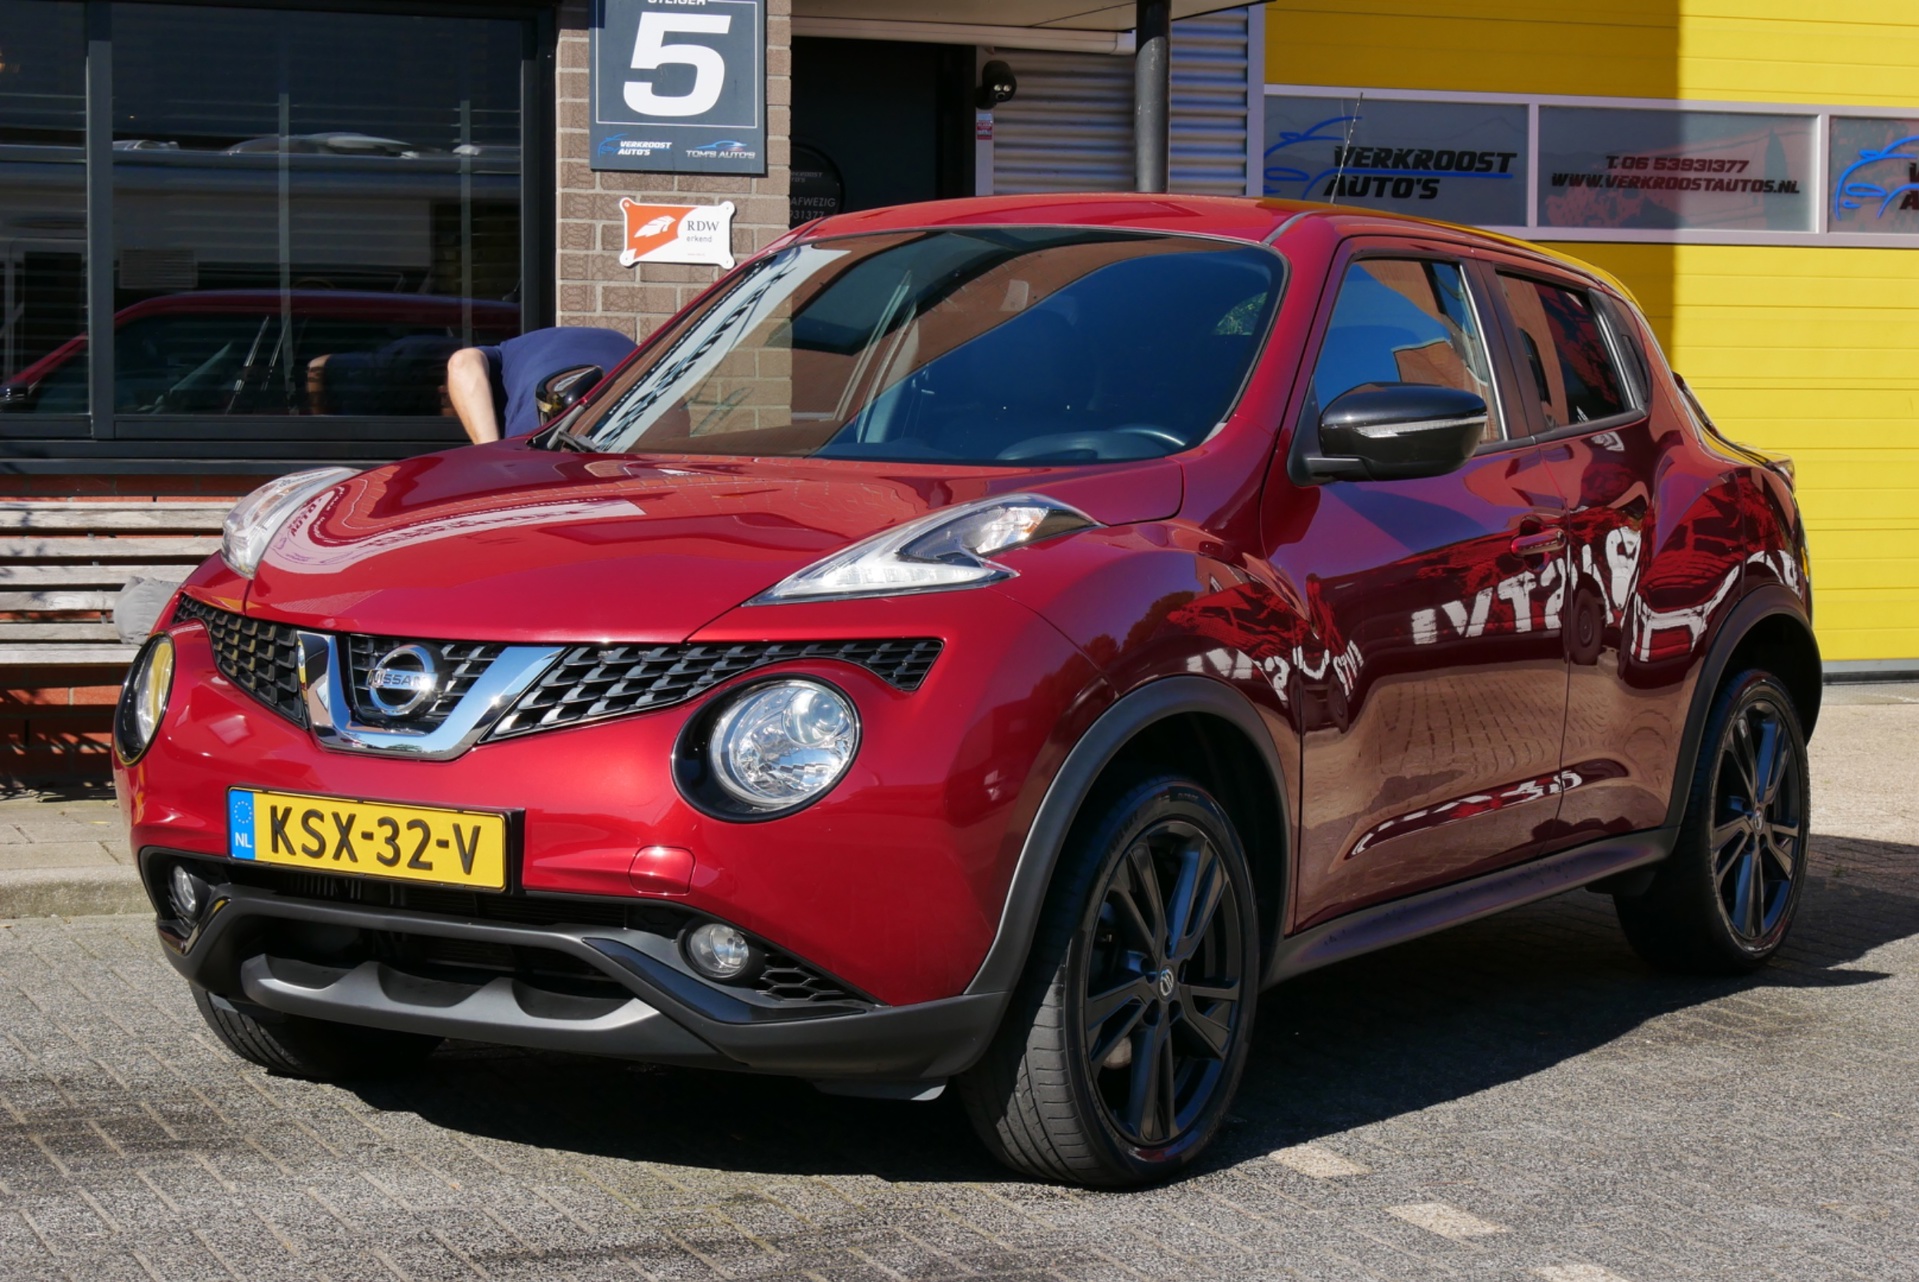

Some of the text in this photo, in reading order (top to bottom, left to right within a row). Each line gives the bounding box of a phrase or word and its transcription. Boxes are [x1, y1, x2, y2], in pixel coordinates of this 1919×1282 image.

[623, 11, 732, 117] 5
[620, 140, 672, 150] VERKROOST
[686, 150, 756, 159] TOM'S AUTO'S
[1334, 146, 1518, 174] VERKROOST
[1653, 157, 1750, 174] 53931377
[1323, 175, 1441, 200] AUTO'S
[1551, 172, 1801, 195] WWW.VERKROOSTAUTOS.NL
[791, 197, 836, 208] AFWEZIG
[687, 220, 720, 231] RDW
[686, 235, 713, 243] erkend
[235, 831, 253, 849] NL
[269, 804, 482, 876] KSX-32-V
